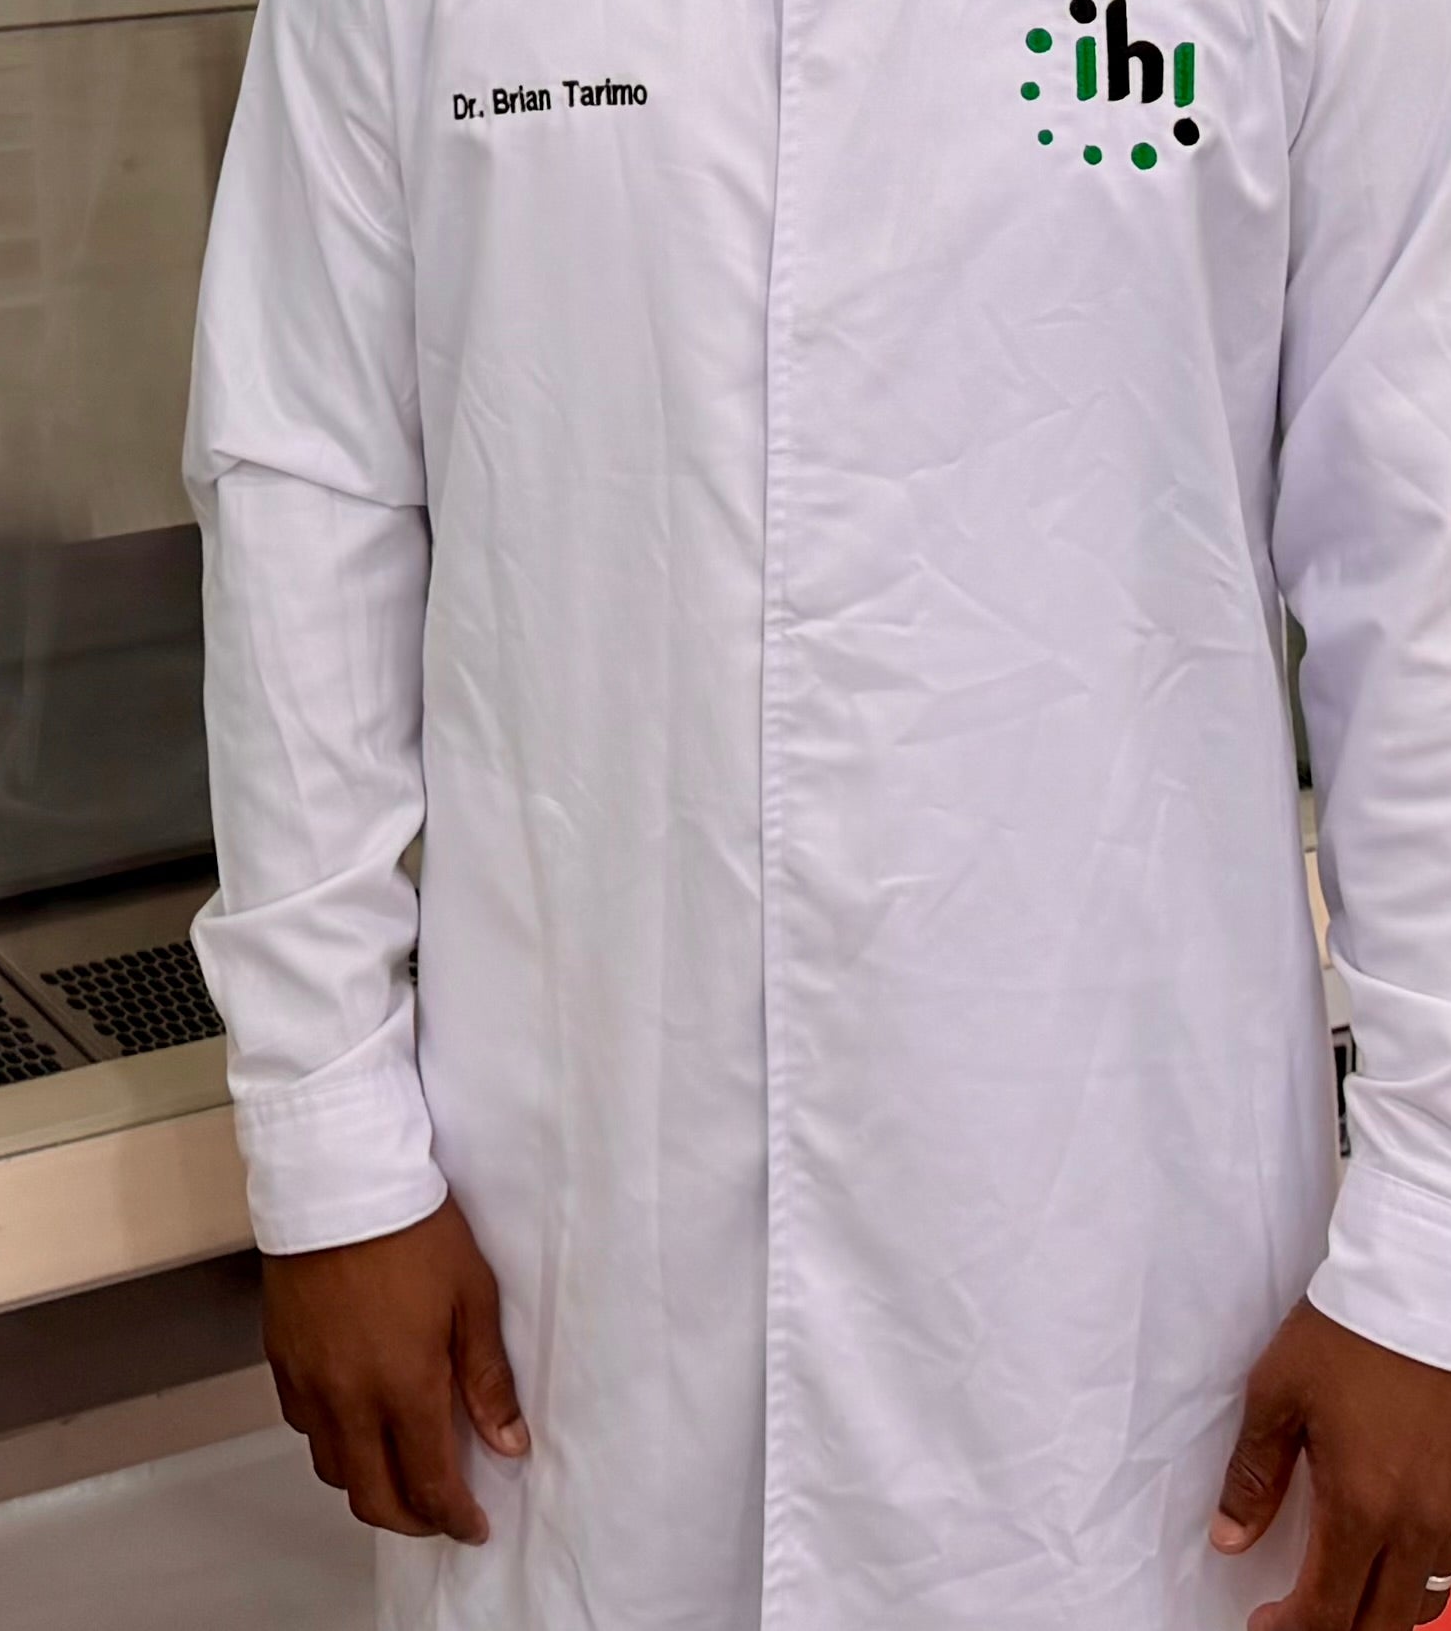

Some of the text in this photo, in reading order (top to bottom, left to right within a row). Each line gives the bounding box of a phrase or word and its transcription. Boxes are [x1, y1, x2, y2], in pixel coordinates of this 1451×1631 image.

[453, 78, 648, 120] Dr. Brian Tarimo
